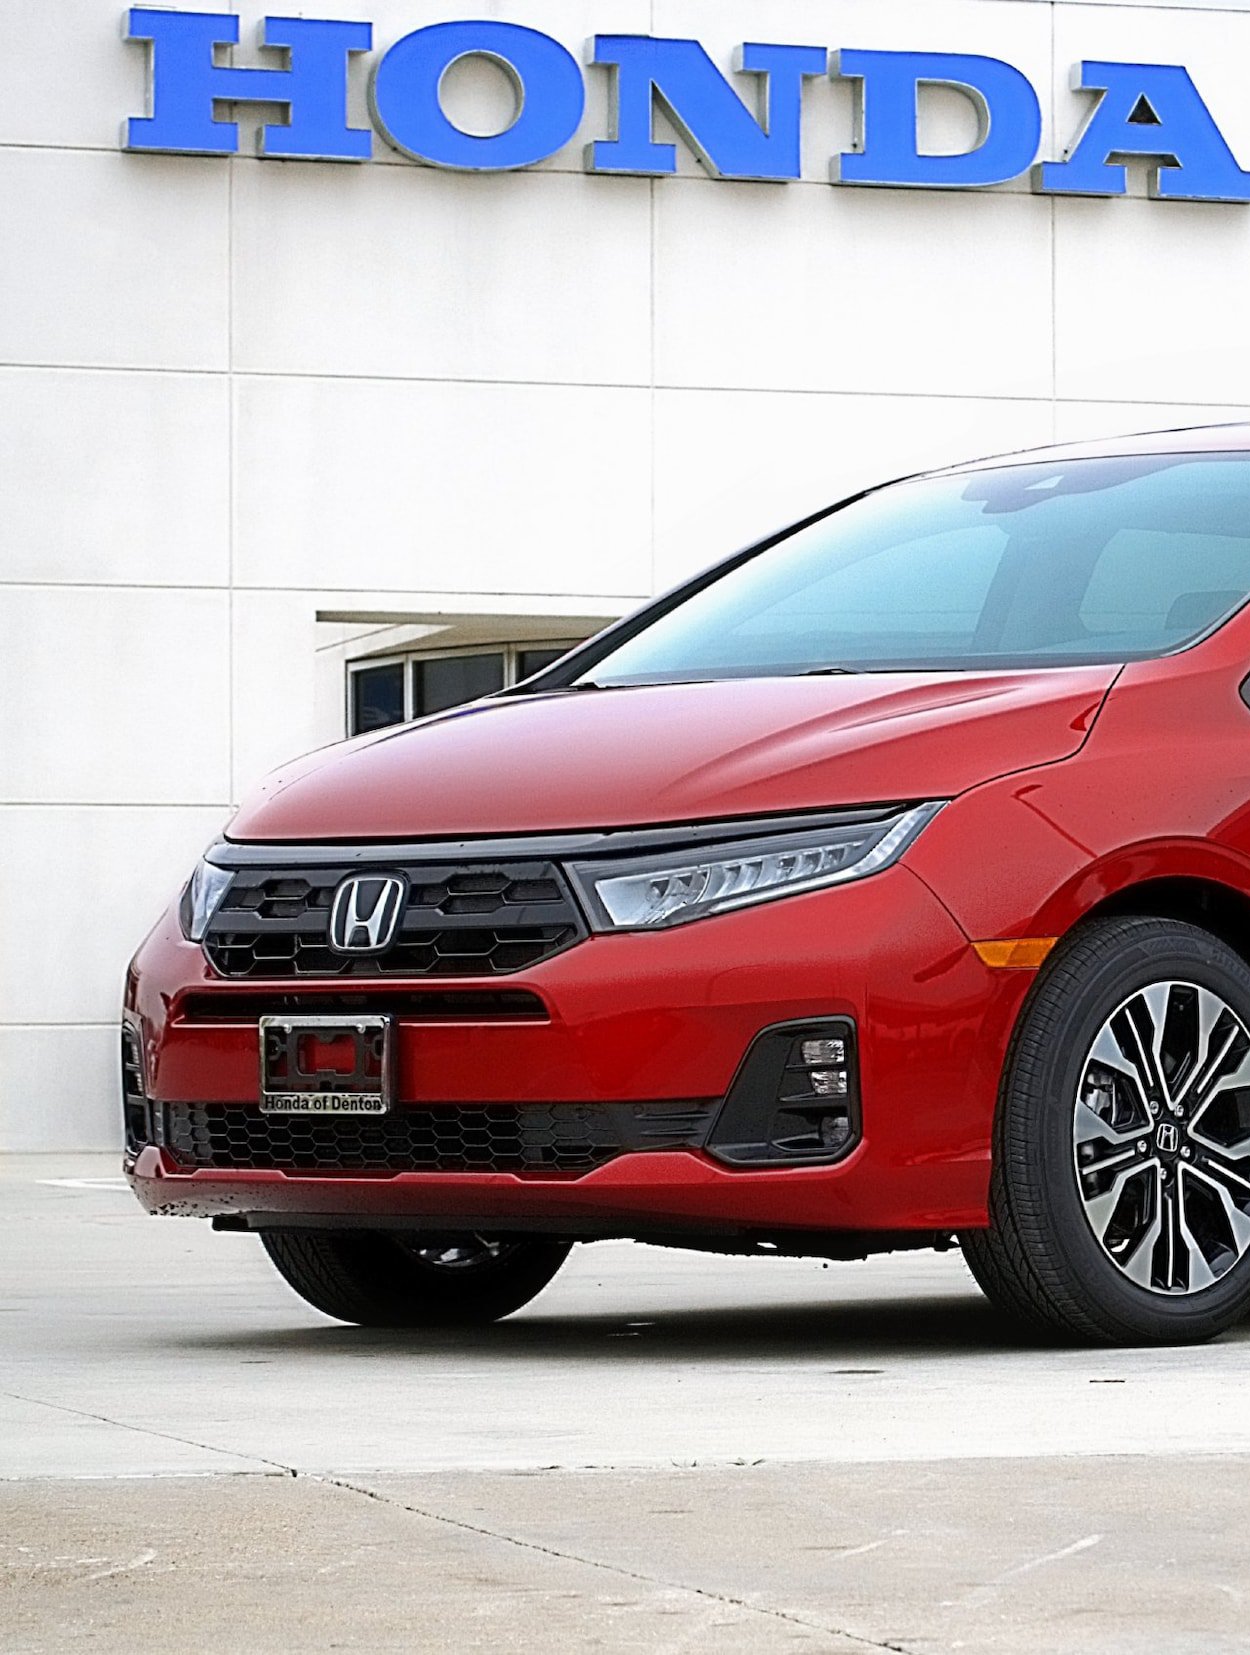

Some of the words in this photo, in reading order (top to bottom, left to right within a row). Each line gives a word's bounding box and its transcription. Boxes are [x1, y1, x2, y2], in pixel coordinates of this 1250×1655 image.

[264, 1095, 310, 1110] Honda
[313, 1095, 328, 1110] of
[331, 1095, 382, 1110] Denton
